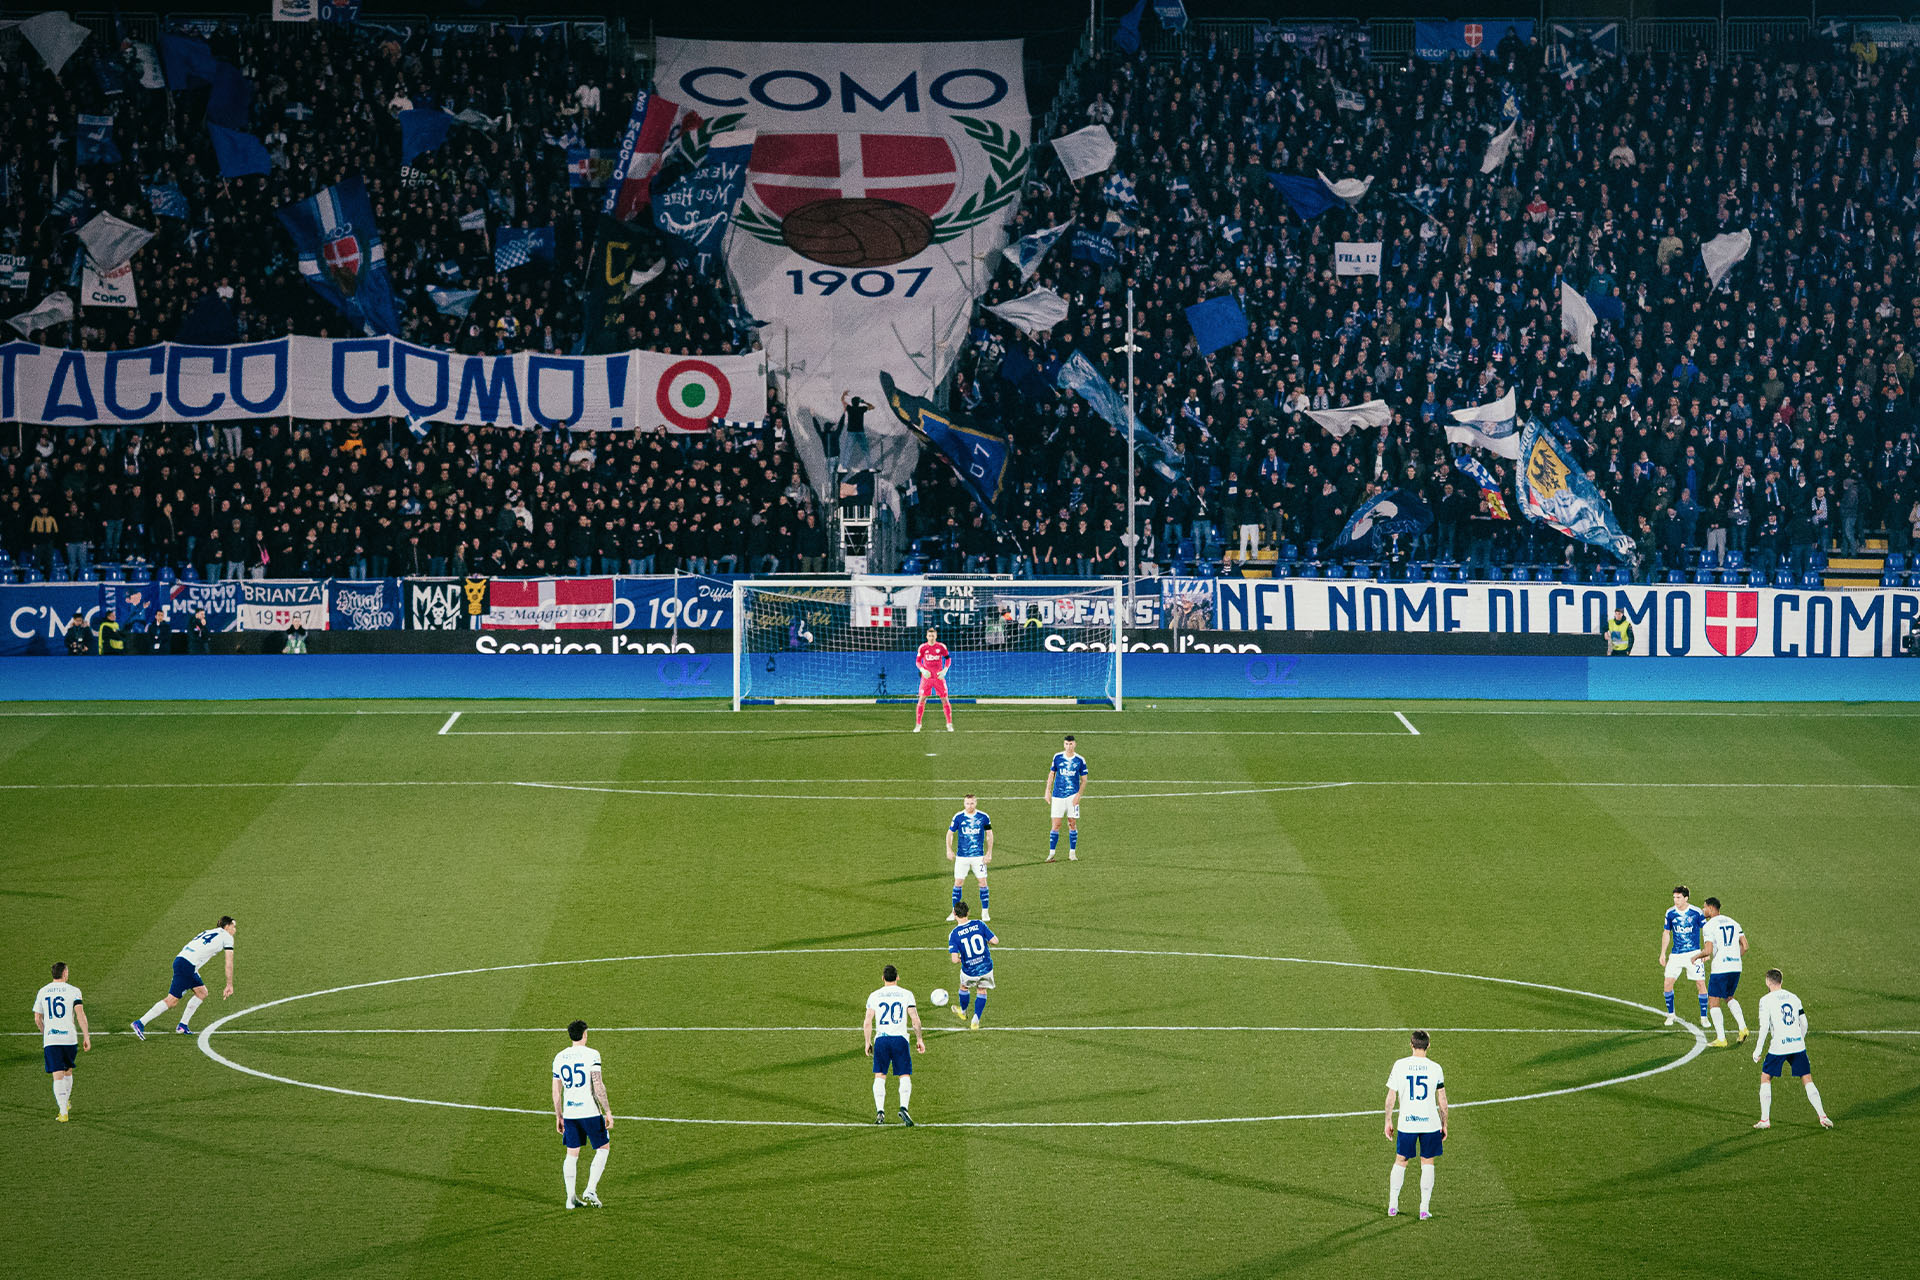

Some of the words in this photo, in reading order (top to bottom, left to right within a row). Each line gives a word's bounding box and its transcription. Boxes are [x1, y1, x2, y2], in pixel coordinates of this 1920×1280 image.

[679, 66, 1008, 114] COMO
[612, 118, 642, 181] MAGGIO
[1339, 253, 1361, 263] FILA
[1366, 253, 1377, 263] 12
[786, 267, 932, 297] 1907
[189, 585, 236, 600] COMO
[244, 586, 322, 601] BRIANZA
[172, 599, 236, 614] MCMVII
[489, 611, 505, 620] 25
[510, 606, 568, 623] Maggio
[573, 608, 606, 619] 1907
[1327, 585, 1470, 633] NOME
[1487, 588, 1529, 633] DI
[1549, 588, 1691, 656] COMO
[1060, 768, 1077, 776] Uber
[961, 826, 981, 835] Uber
[1673, 925, 1693, 933] Uber
[1719, 925, 1735, 947] 17
[960, 933, 986, 958] 10
[45, 995, 66, 1020] 16
[879, 1001, 904, 1025] 20
[1781, 1003, 1795, 1026] 8
[560, 1063, 587, 1089] 95
[1406, 1075, 1429, 1101] 15
